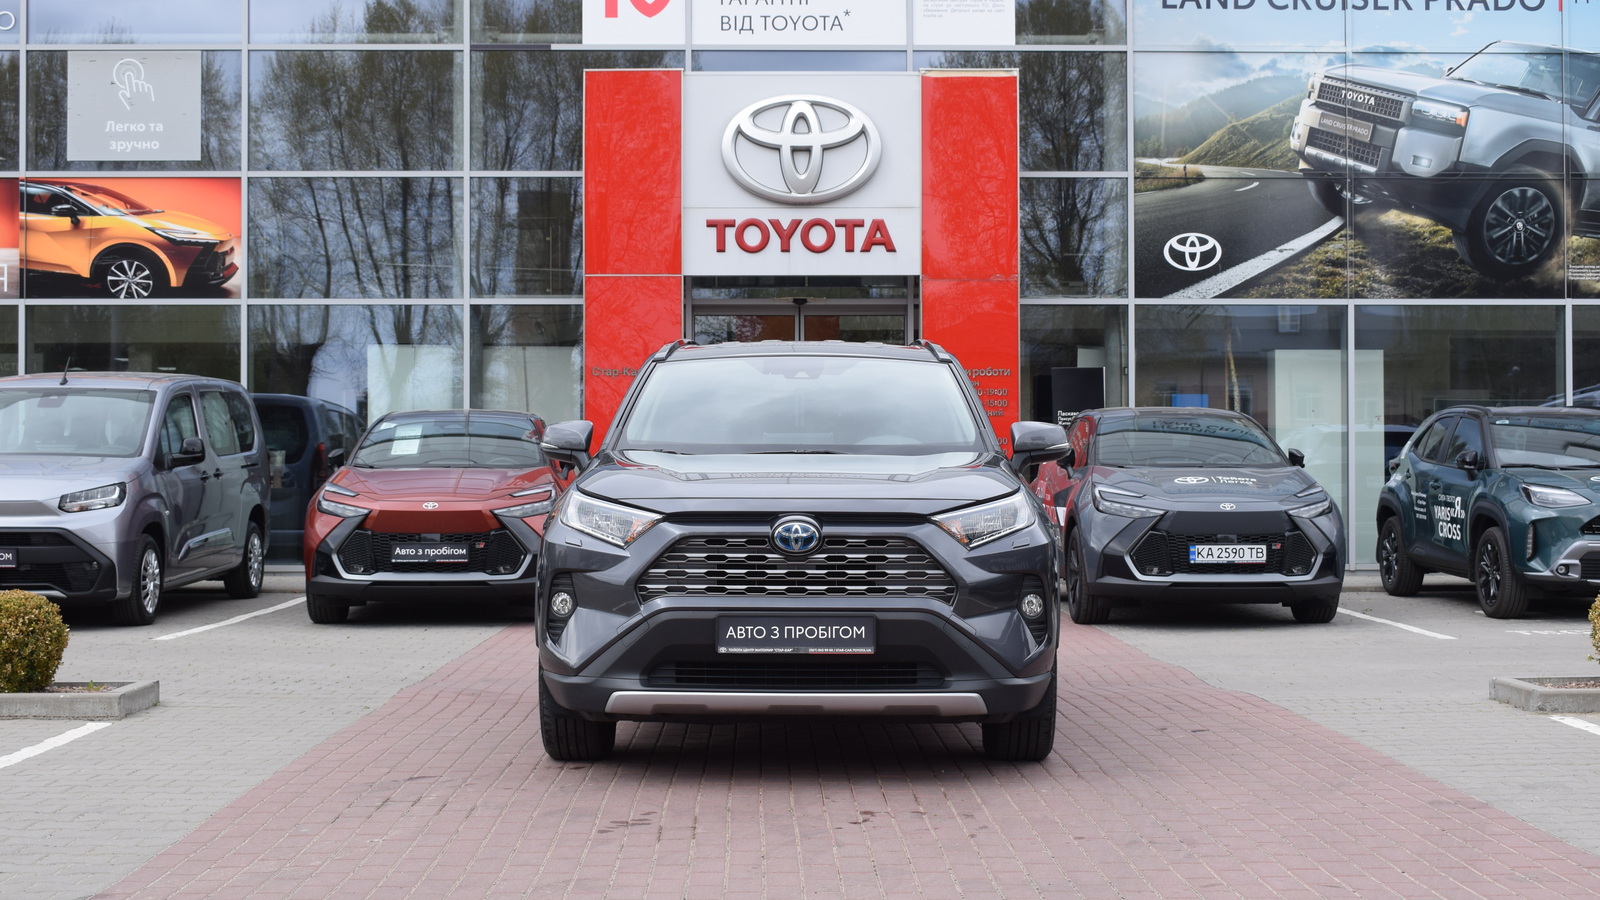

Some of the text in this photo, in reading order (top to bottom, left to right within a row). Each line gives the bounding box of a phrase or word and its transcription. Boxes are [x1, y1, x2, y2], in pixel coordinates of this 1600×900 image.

[720, 15, 754, 35] ВІД
[1341, 90, 1375, 105] TOYOTA
[105, 120, 164, 132] Легко та
[1320, 117, 1333, 126] LAND
[1353, 125, 1369, 136] PRADO
[109, 140, 160, 152] зручно
[706, 217, 897, 254] TOYOTA
[591, 366, 638, 378] Стар-Ка
[972, 366, 1011, 378] роботи
[1433, 504, 1450, 521] YARIS
[1438, 521, 1462, 541] CROSS
[394, 547, 416, 555] Авто
[424, 546, 467, 557] пробігом
[1196, 547, 1214, 559] KA
[1216, 547, 1245, 559] 2590
[1248, 547, 1265, 559] TB
[725, 625, 866, 639] АВТО З ПРОБІГОМ
